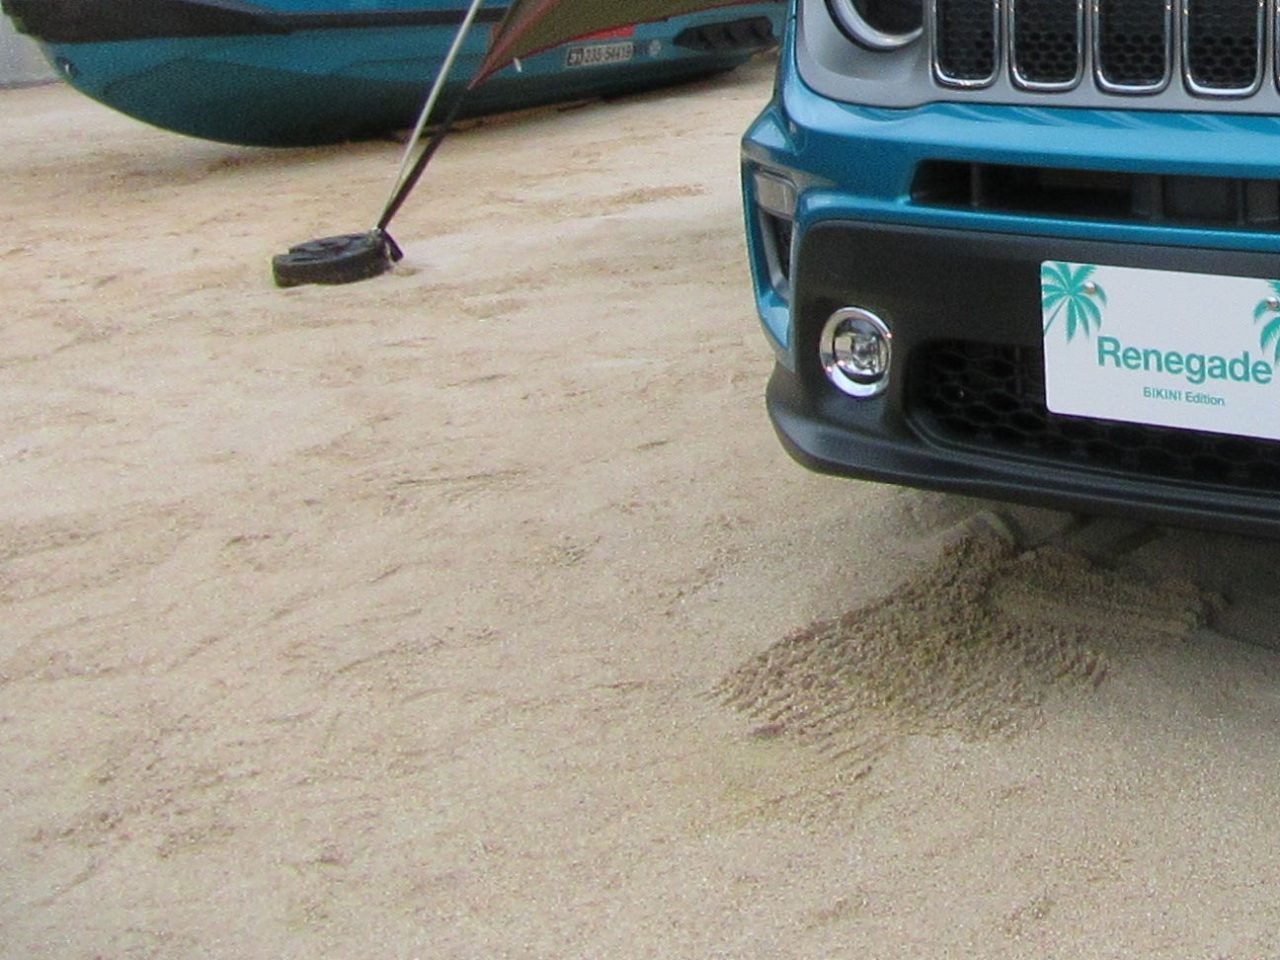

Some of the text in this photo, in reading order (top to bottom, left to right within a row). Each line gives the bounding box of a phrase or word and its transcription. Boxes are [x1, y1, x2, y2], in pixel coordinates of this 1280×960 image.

[1097, 336, 1273, 384] Renegade
[1143, 387, 1226, 406] BIKINI Edition
